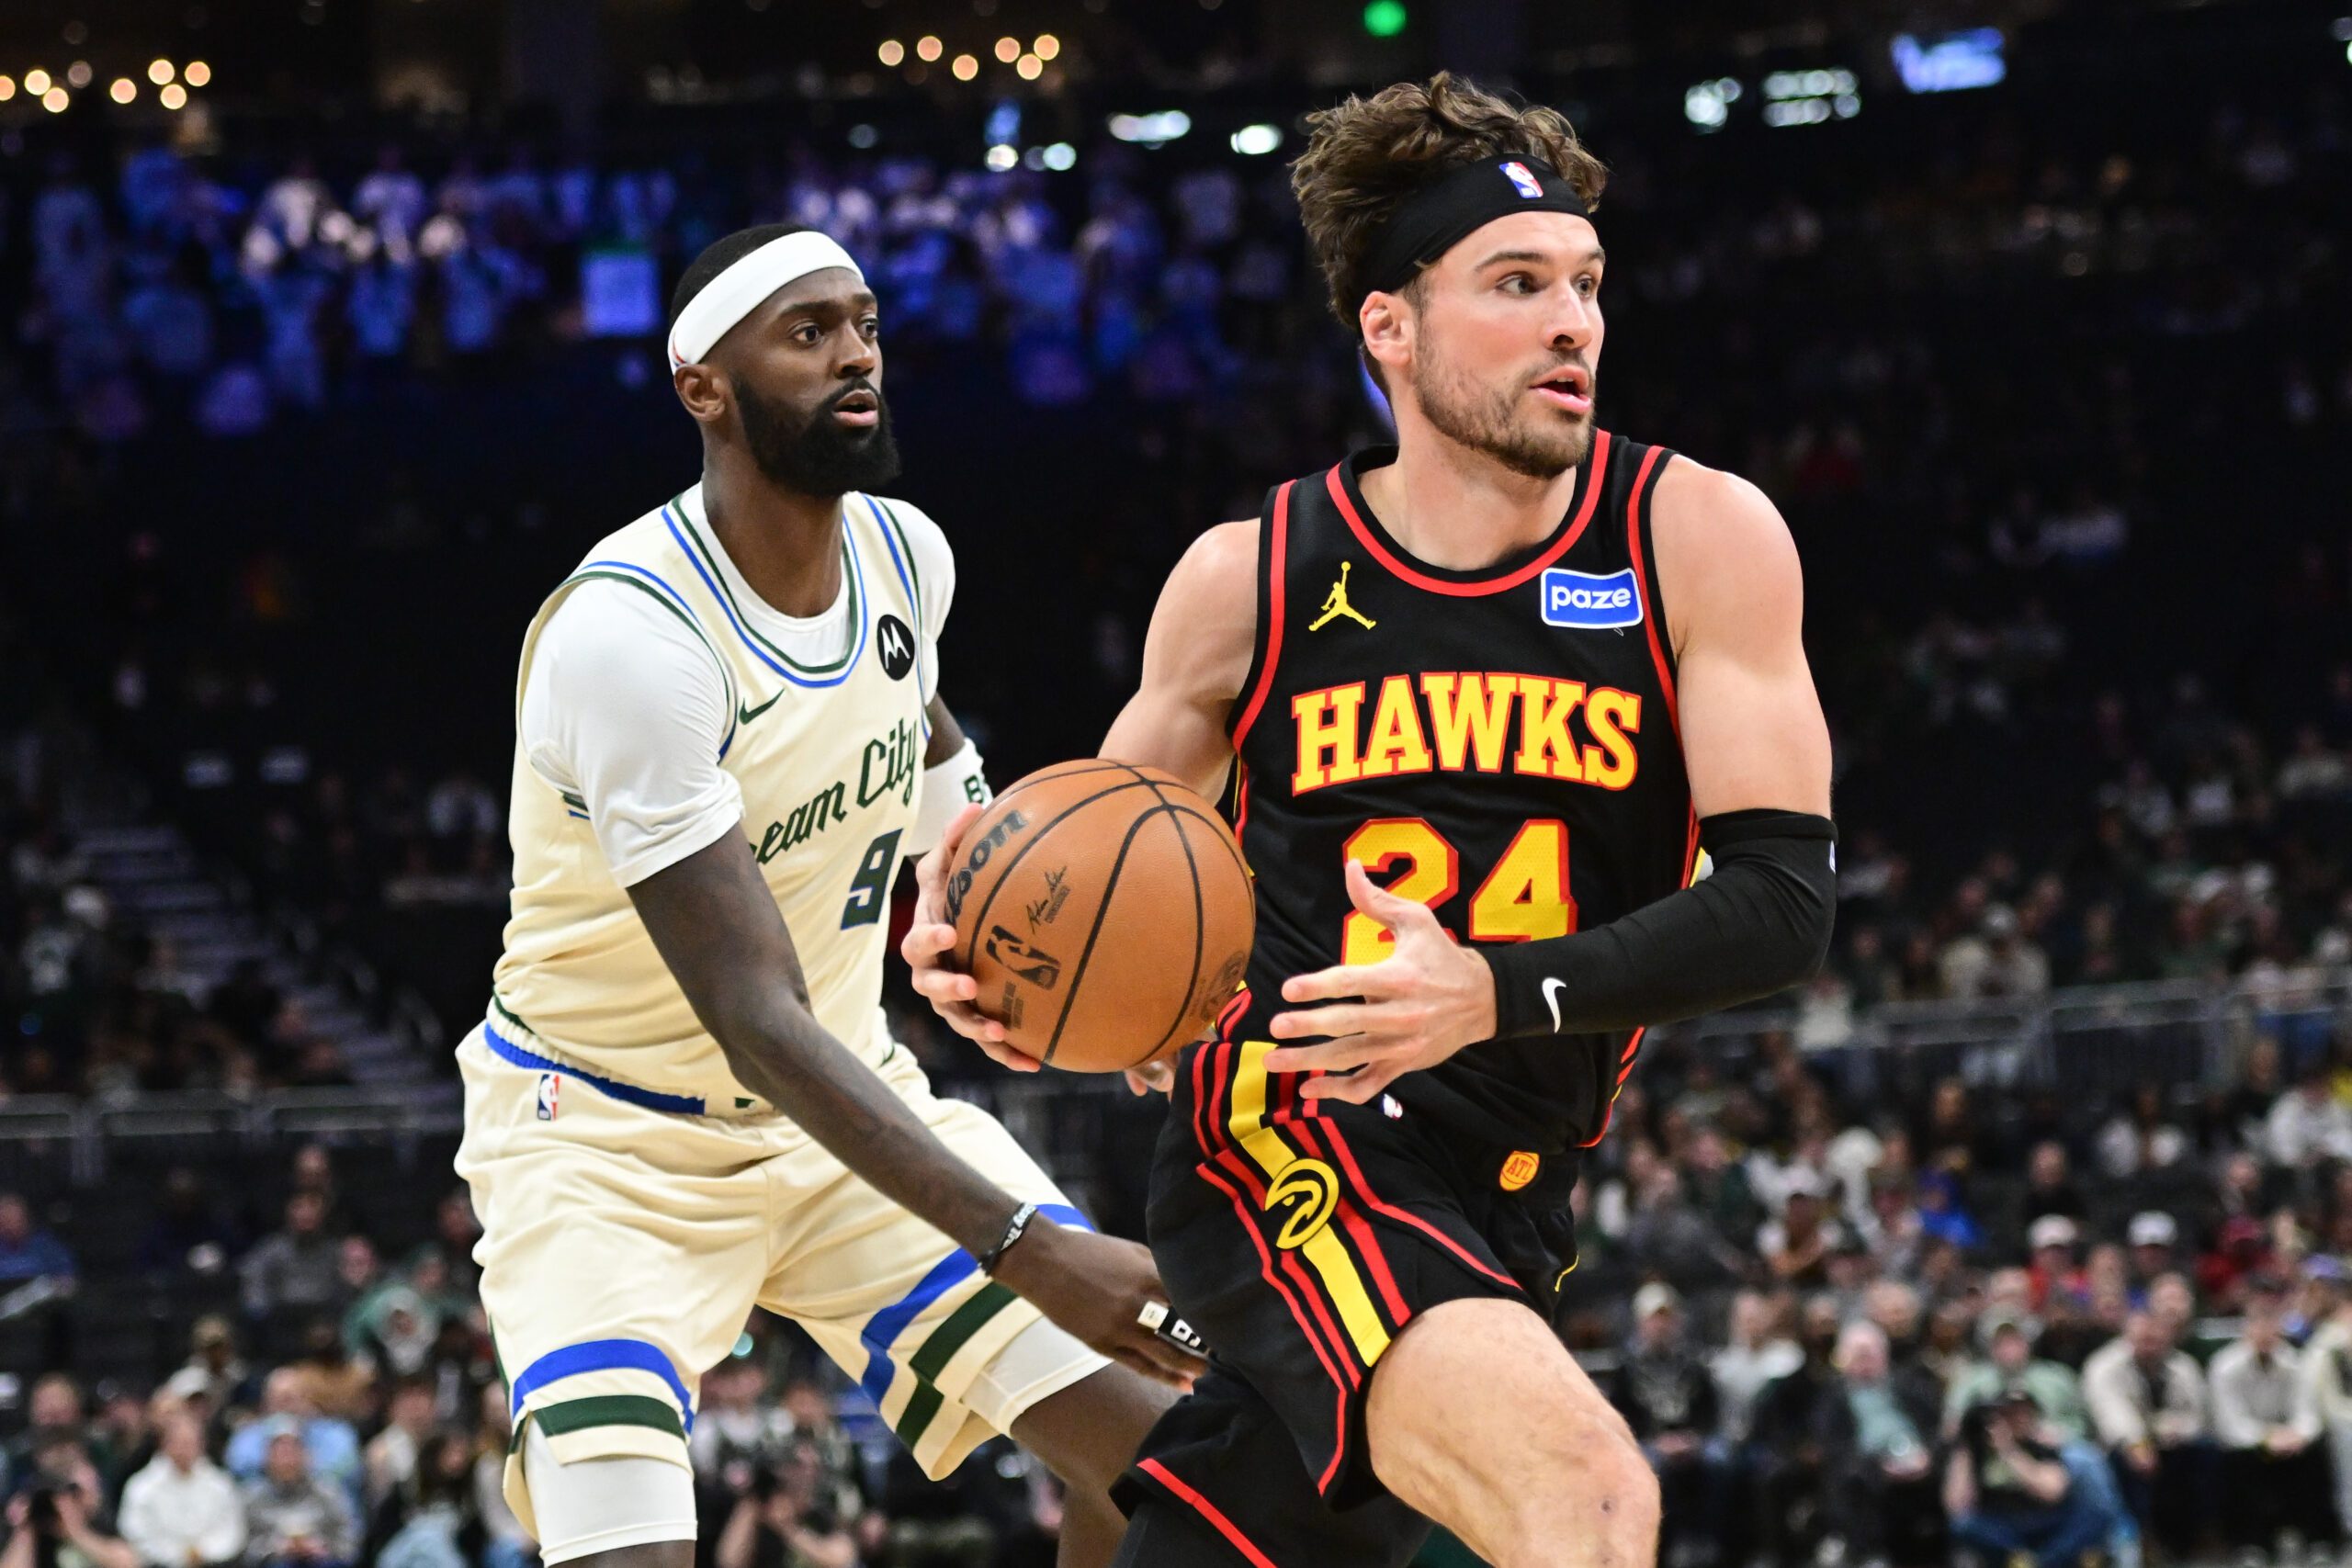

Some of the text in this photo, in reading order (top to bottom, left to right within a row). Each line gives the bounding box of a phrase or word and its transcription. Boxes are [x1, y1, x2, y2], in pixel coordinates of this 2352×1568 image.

[1551, 585, 1632, 612] paze
[749, 717, 918, 865] eam City
[1292, 671, 1642, 797] HAWKS
[840, 829, 903, 931] 9
[1341, 817, 1577, 966] 24
[1506, 1156, 1533, 1180] ATL
